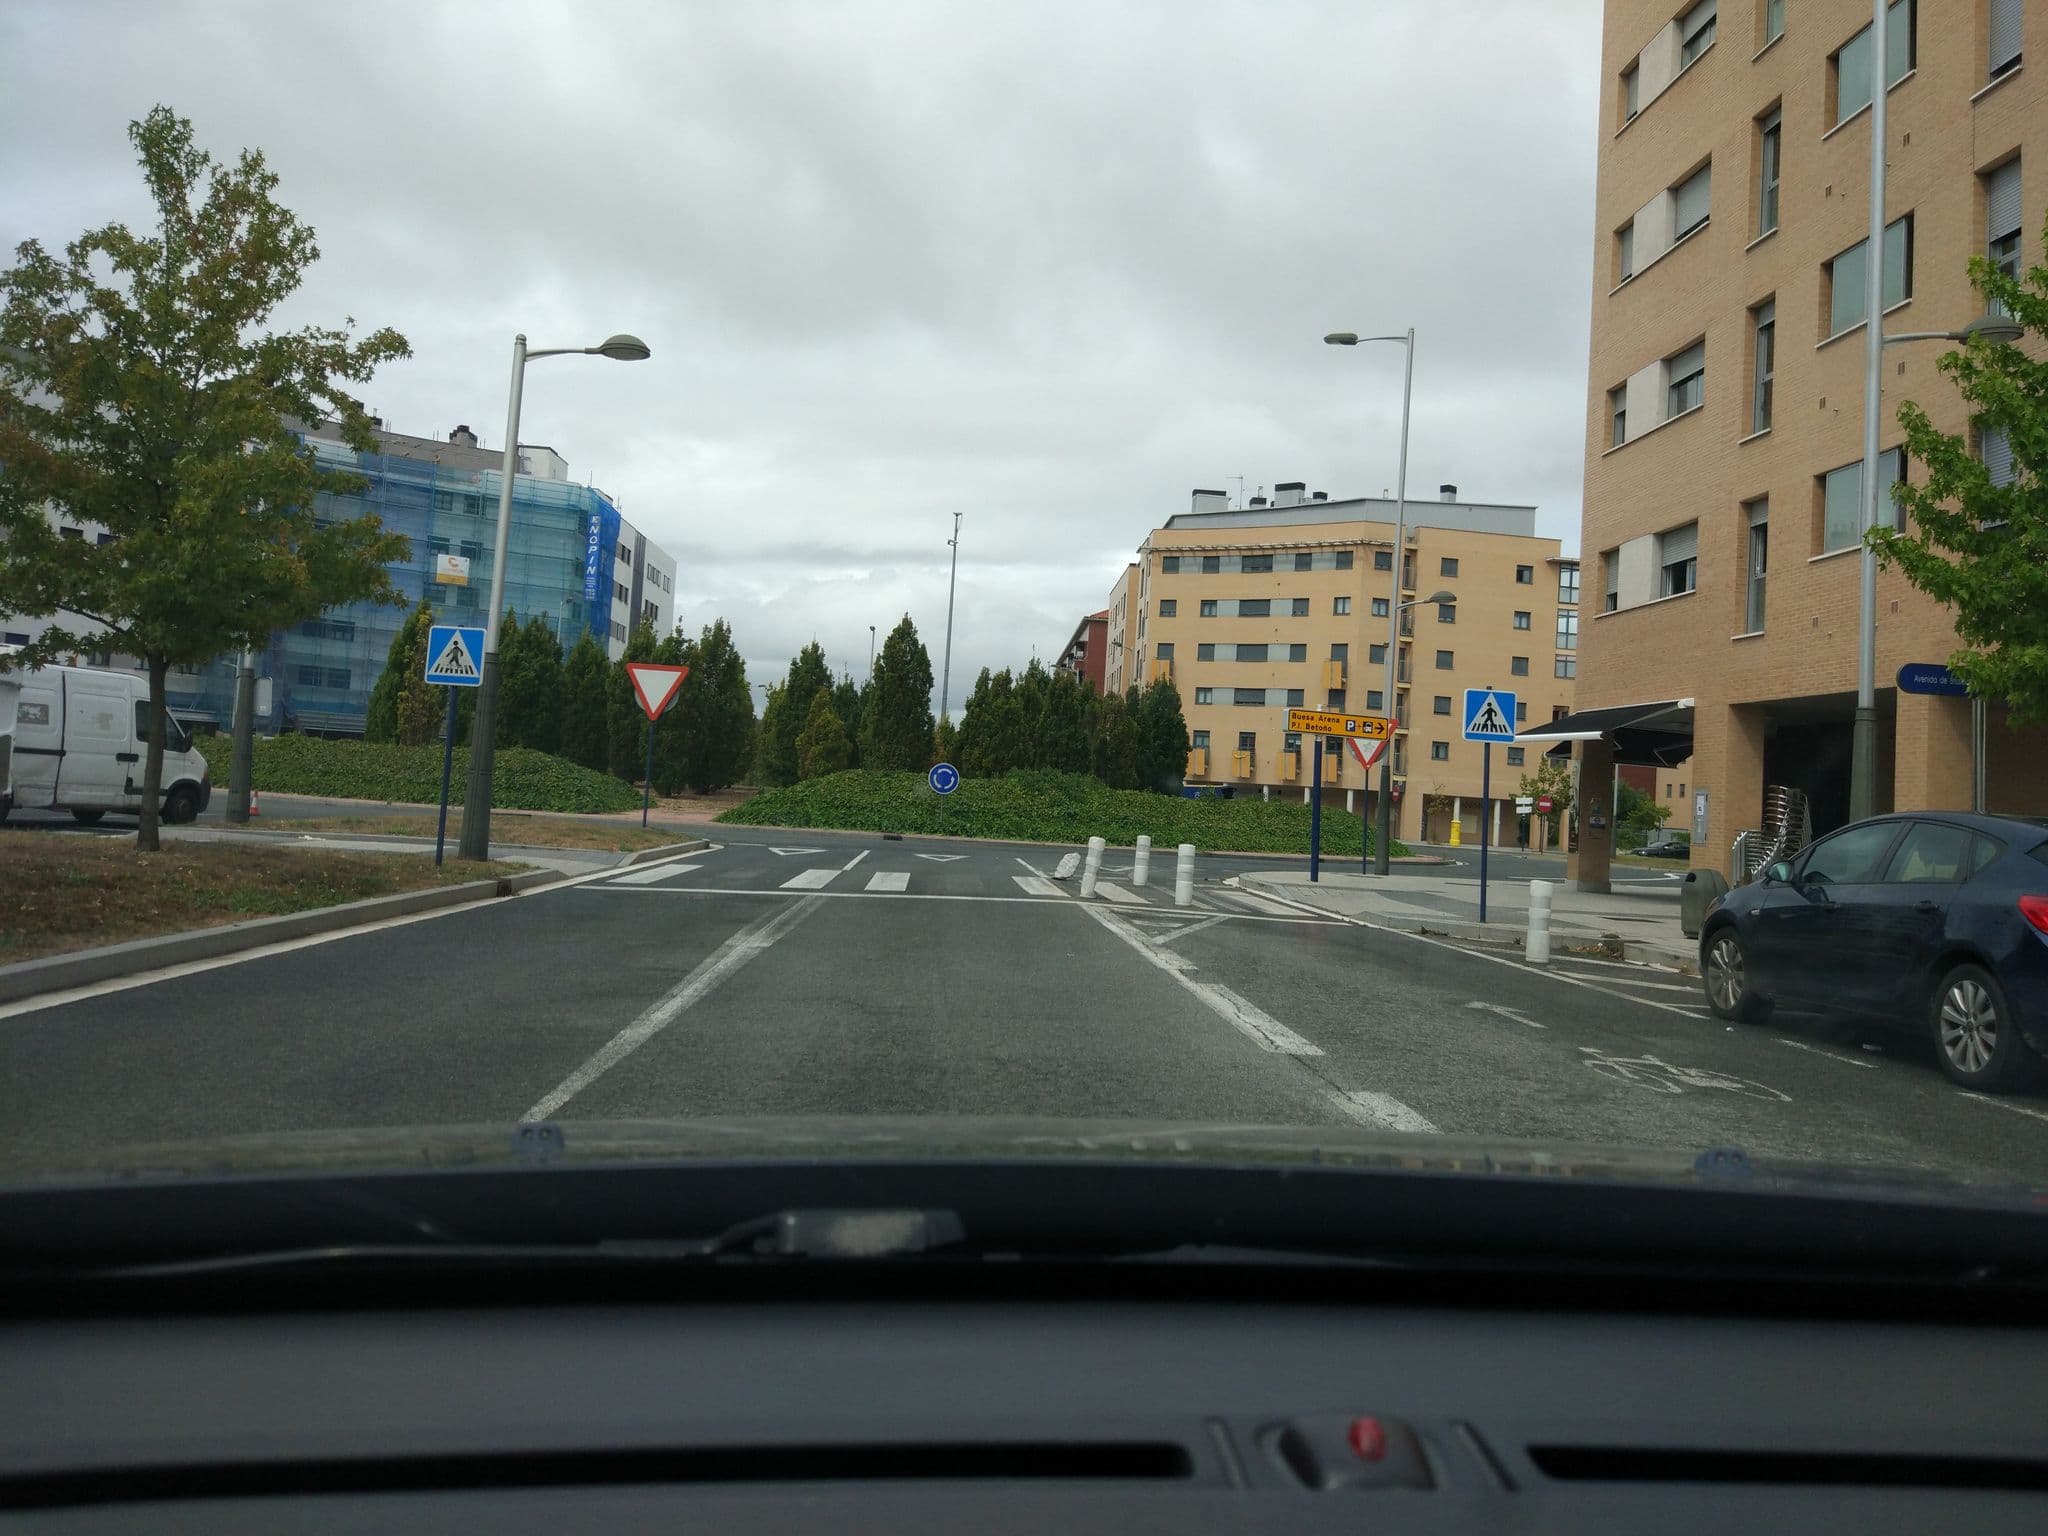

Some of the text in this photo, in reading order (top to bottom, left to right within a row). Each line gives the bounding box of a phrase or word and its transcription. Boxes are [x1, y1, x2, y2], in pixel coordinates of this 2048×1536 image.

[1914, 675, 1938, 684] Avenida
[1939, 676, 1948, 684] de
[1291, 712, 1340, 723] Buesa Arena
